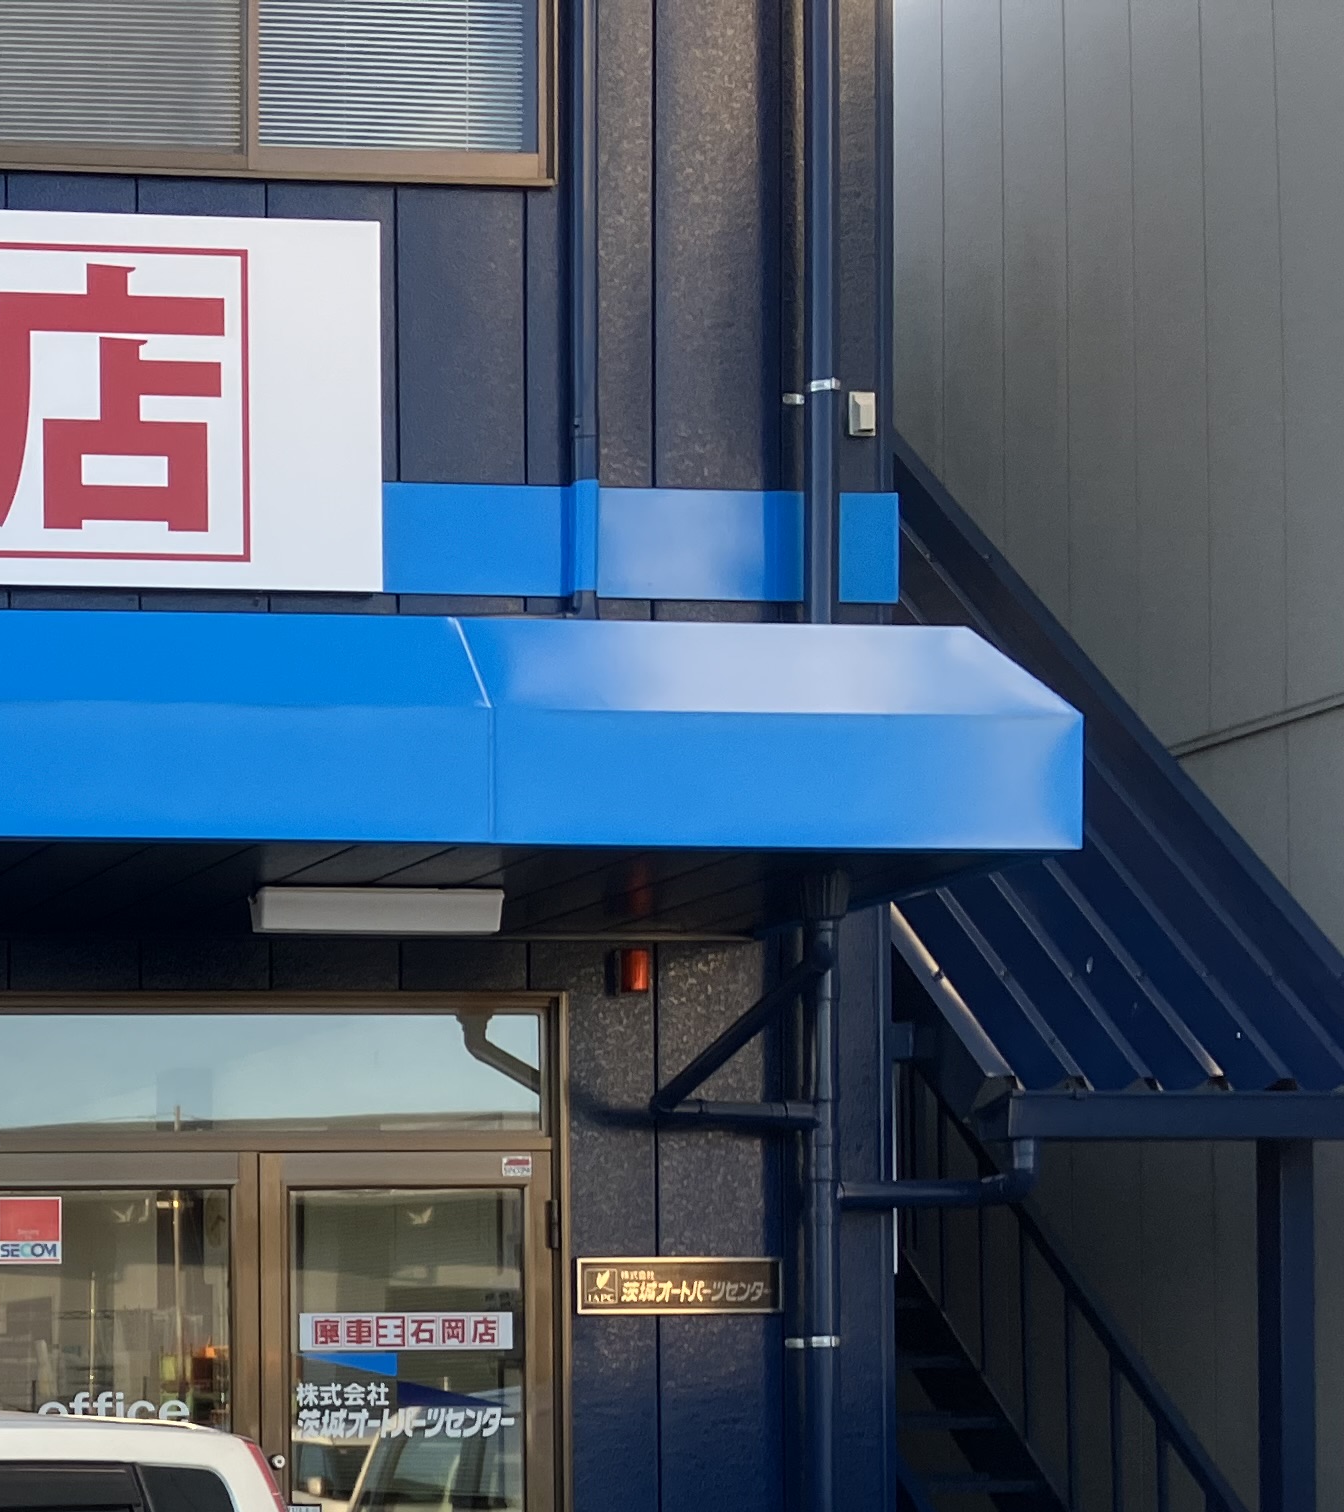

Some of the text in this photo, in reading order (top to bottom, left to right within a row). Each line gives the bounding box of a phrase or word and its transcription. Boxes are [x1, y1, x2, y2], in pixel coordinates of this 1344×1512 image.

[0, 1243, 57, 1258] SECOM
[620, 1280, 772, 1303] 茨城オートパーツセンター
[314, 1316, 498, 1347] 廃車王石岡店
[296, 1382, 389, 1406] 株式会社
[297, 1407, 515, 1438] 茨城オートパーツセンター
